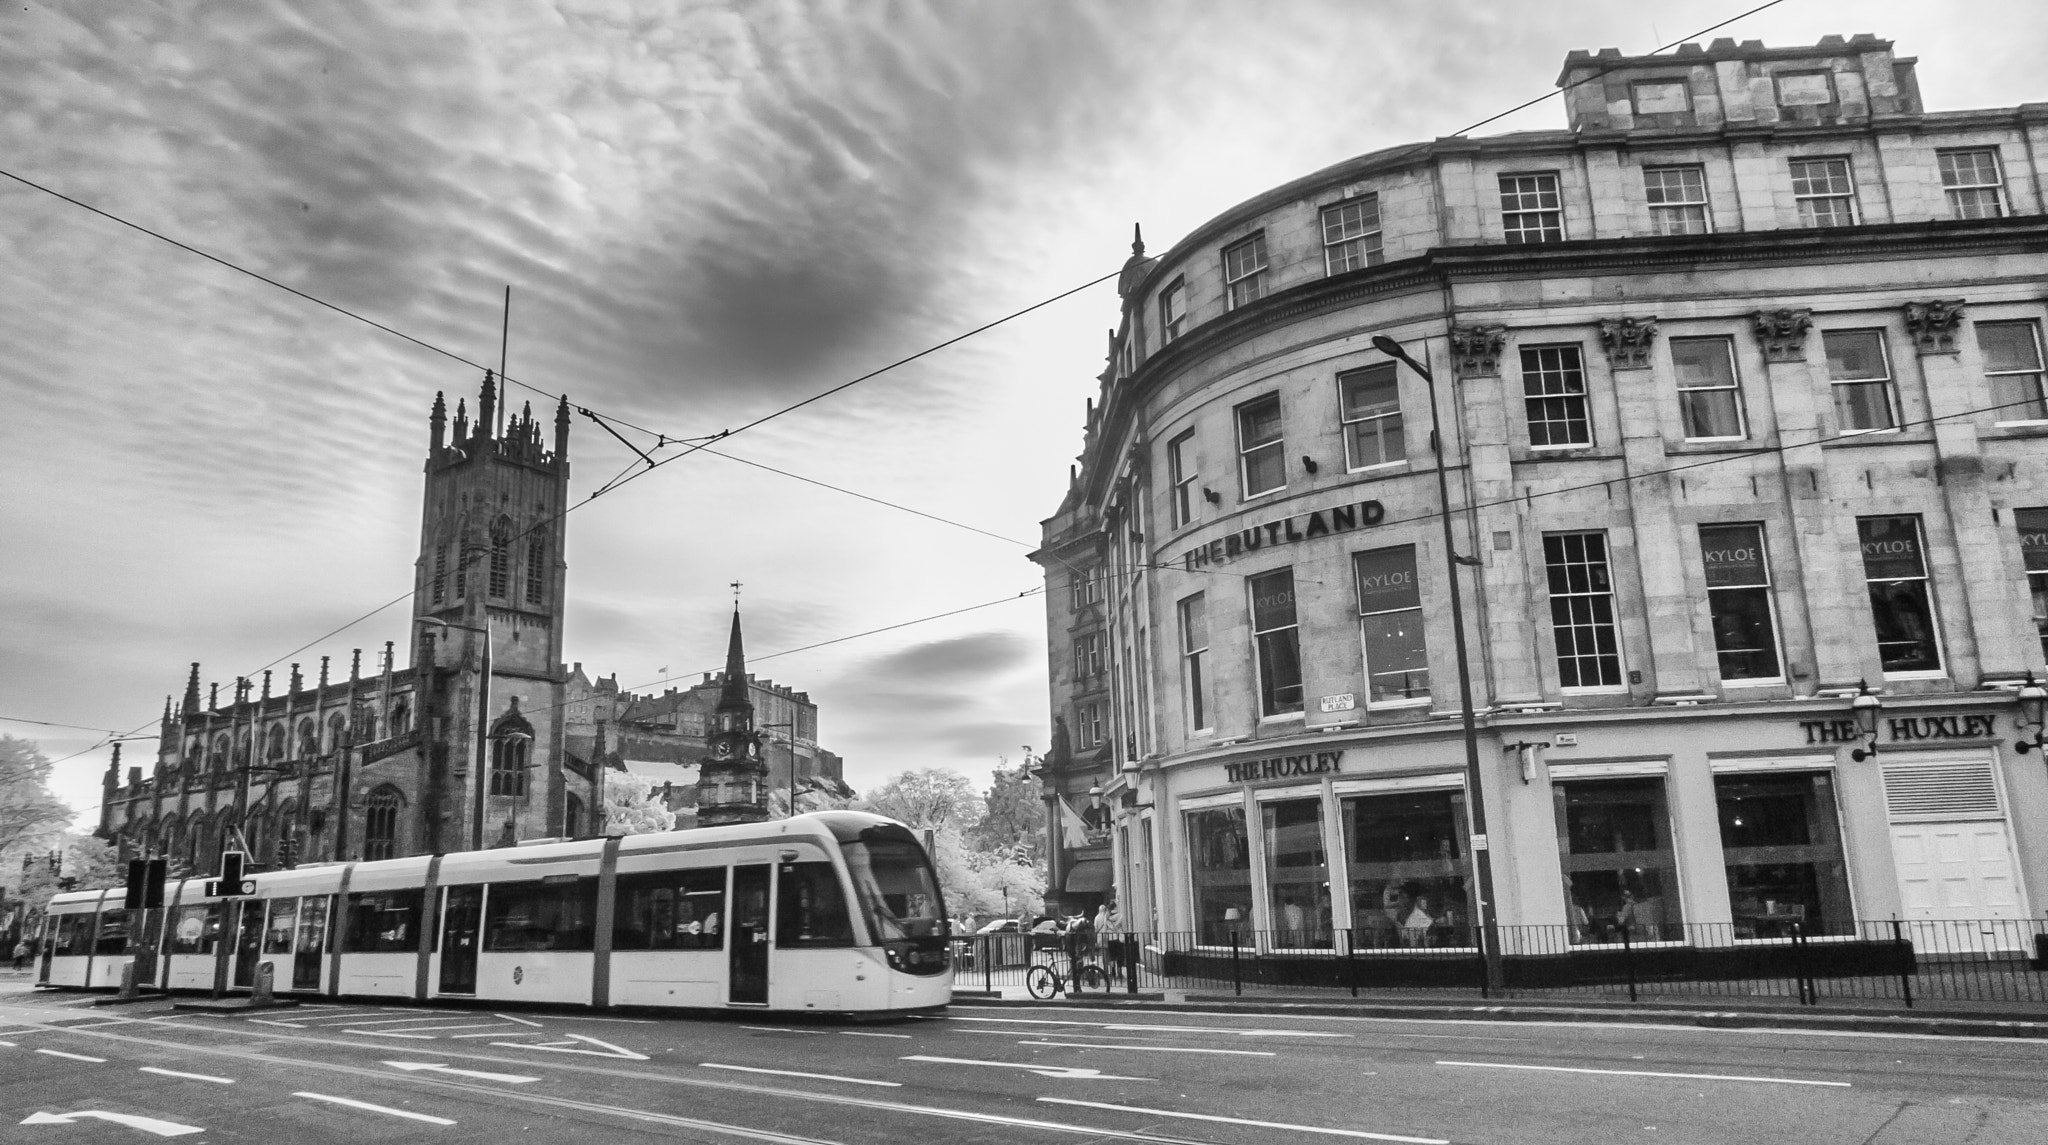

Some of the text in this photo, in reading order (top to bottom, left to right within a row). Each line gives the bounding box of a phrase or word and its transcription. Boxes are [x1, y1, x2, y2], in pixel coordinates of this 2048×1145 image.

[1225, 499, 1385, 556] RUTLAND
[1861, 540, 1914, 554] KYLOE
[2020, 533, 2048, 546] KYL
[1705, 548, 1757, 562] KYLOE
[1363, 571, 1411, 589] KYLOE
[1256, 591, 1293, 608] KYLOE
[1800, 714, 1997, 744] THE HUXLEY
[1224, 751, 1344, 783] THE HUXLEY
